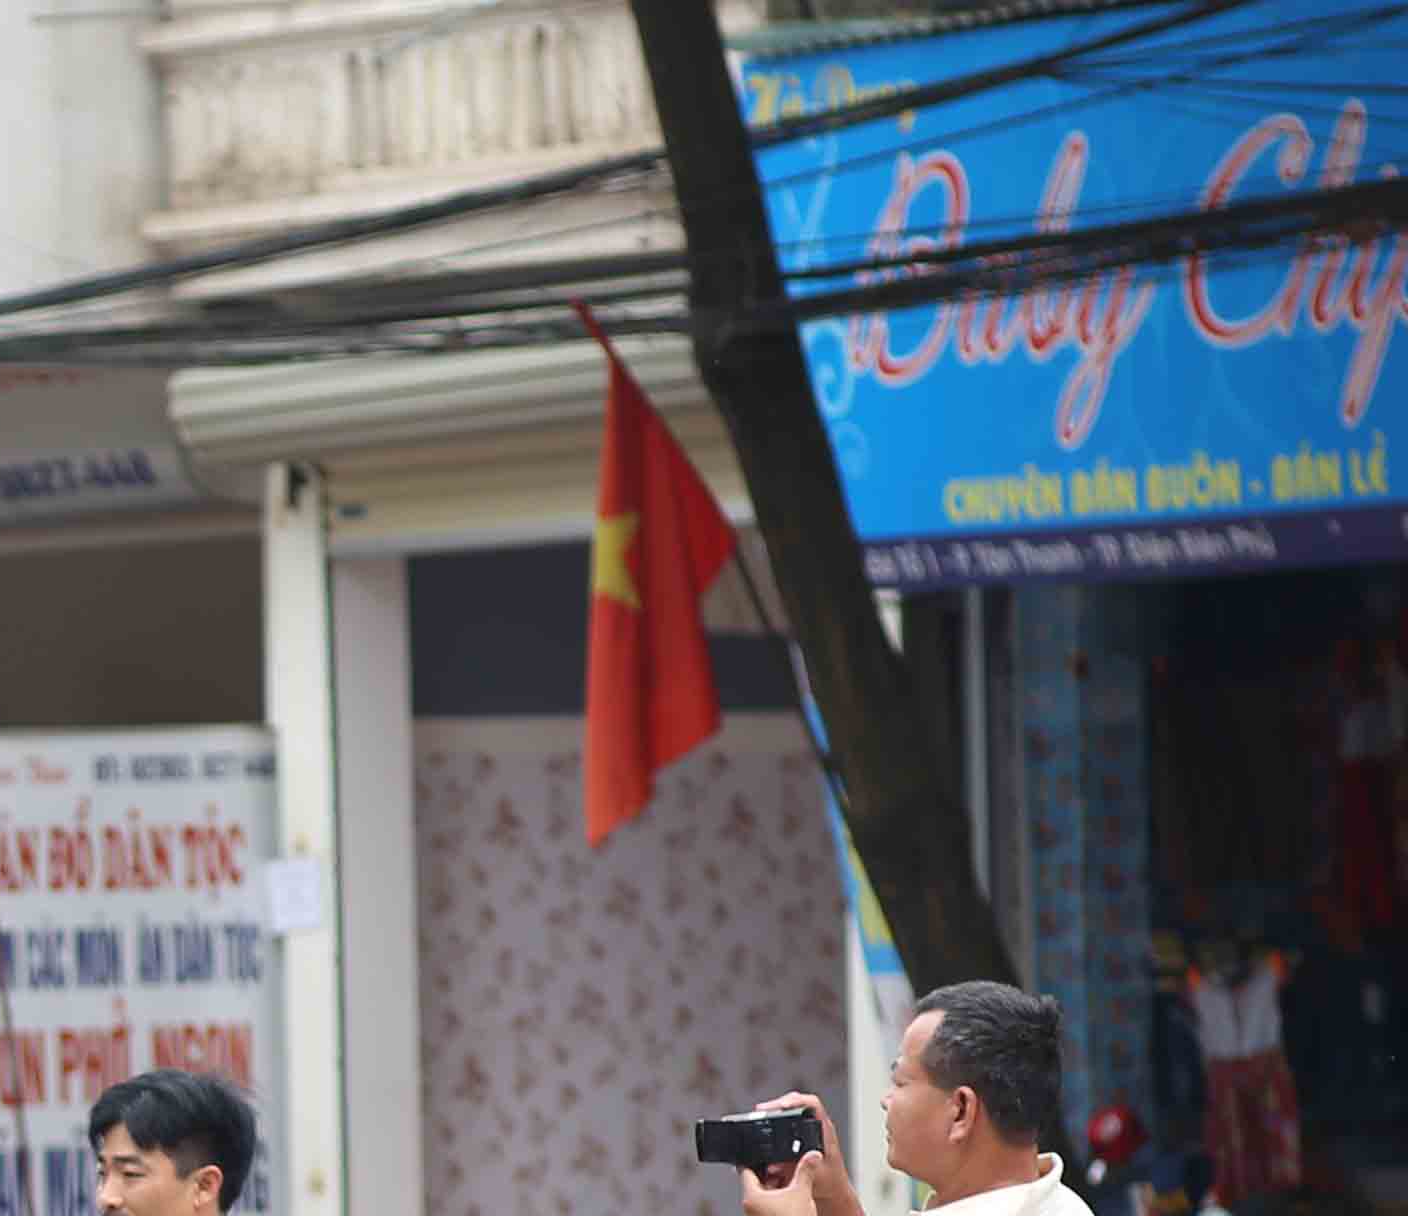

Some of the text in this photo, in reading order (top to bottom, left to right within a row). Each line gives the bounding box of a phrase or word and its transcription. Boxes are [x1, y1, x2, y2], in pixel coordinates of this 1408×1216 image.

[945, 463, 1062, 524] CHUYÊN
[1070, 456, 1137, 515] BÁN
[1146, 448, 1241, 509] BUÔN
[1271, 440, 1341, 501] BÁN
